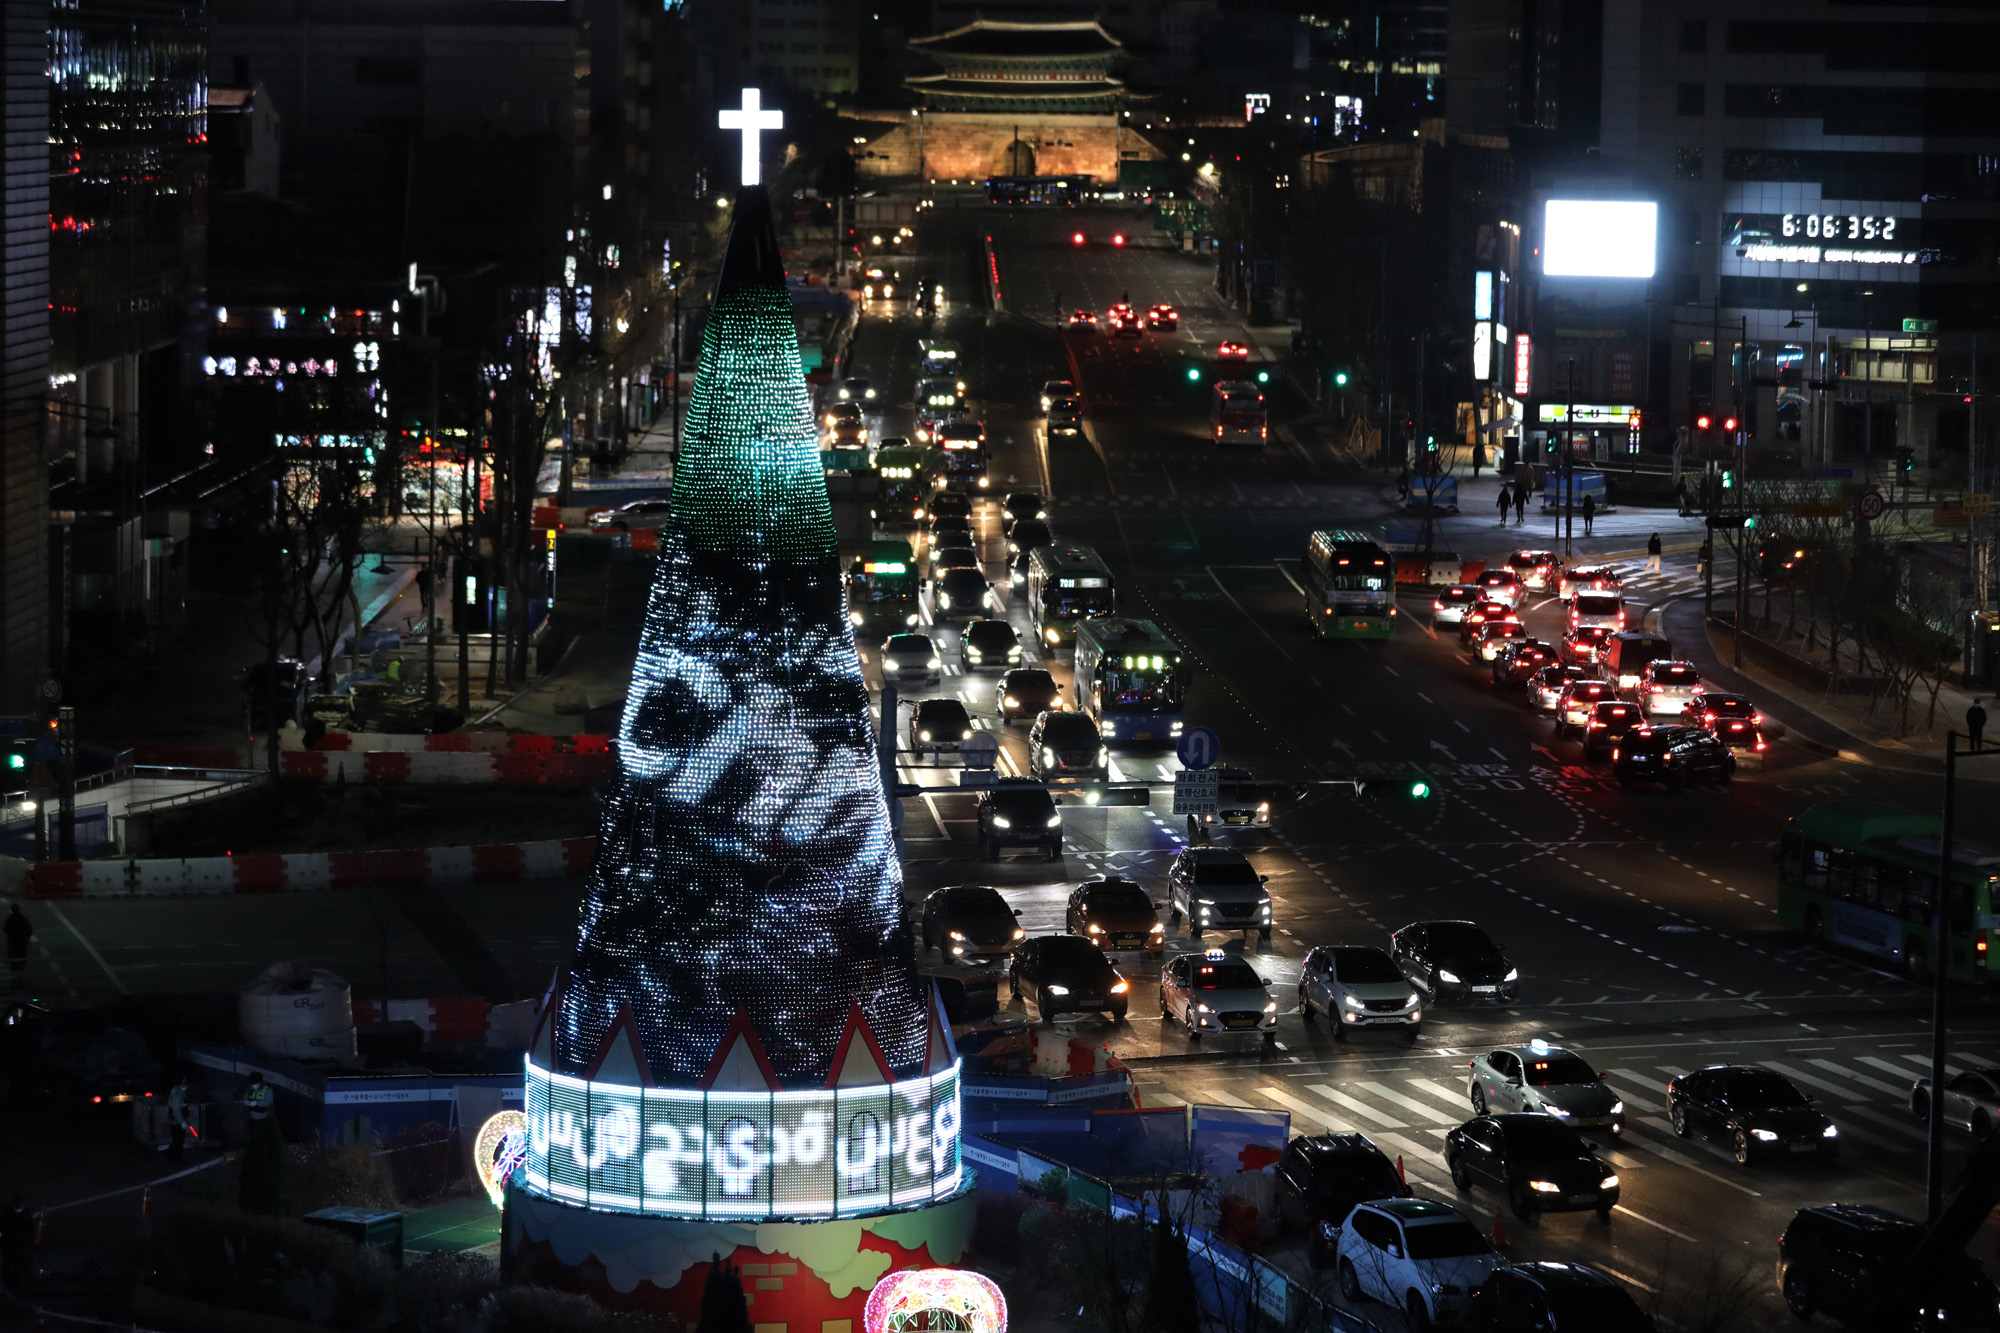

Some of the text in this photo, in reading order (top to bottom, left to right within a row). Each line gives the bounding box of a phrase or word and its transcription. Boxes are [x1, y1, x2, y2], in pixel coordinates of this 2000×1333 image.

[1863, 498, 1879, 513] 50
[1367, 578, 1382, 587] 1711
[1178, 773, 1217, 783] 좌회전시
[1451, 778, 1526, 791] 50
[1176, 788, 1216, 797] 보행신호시
